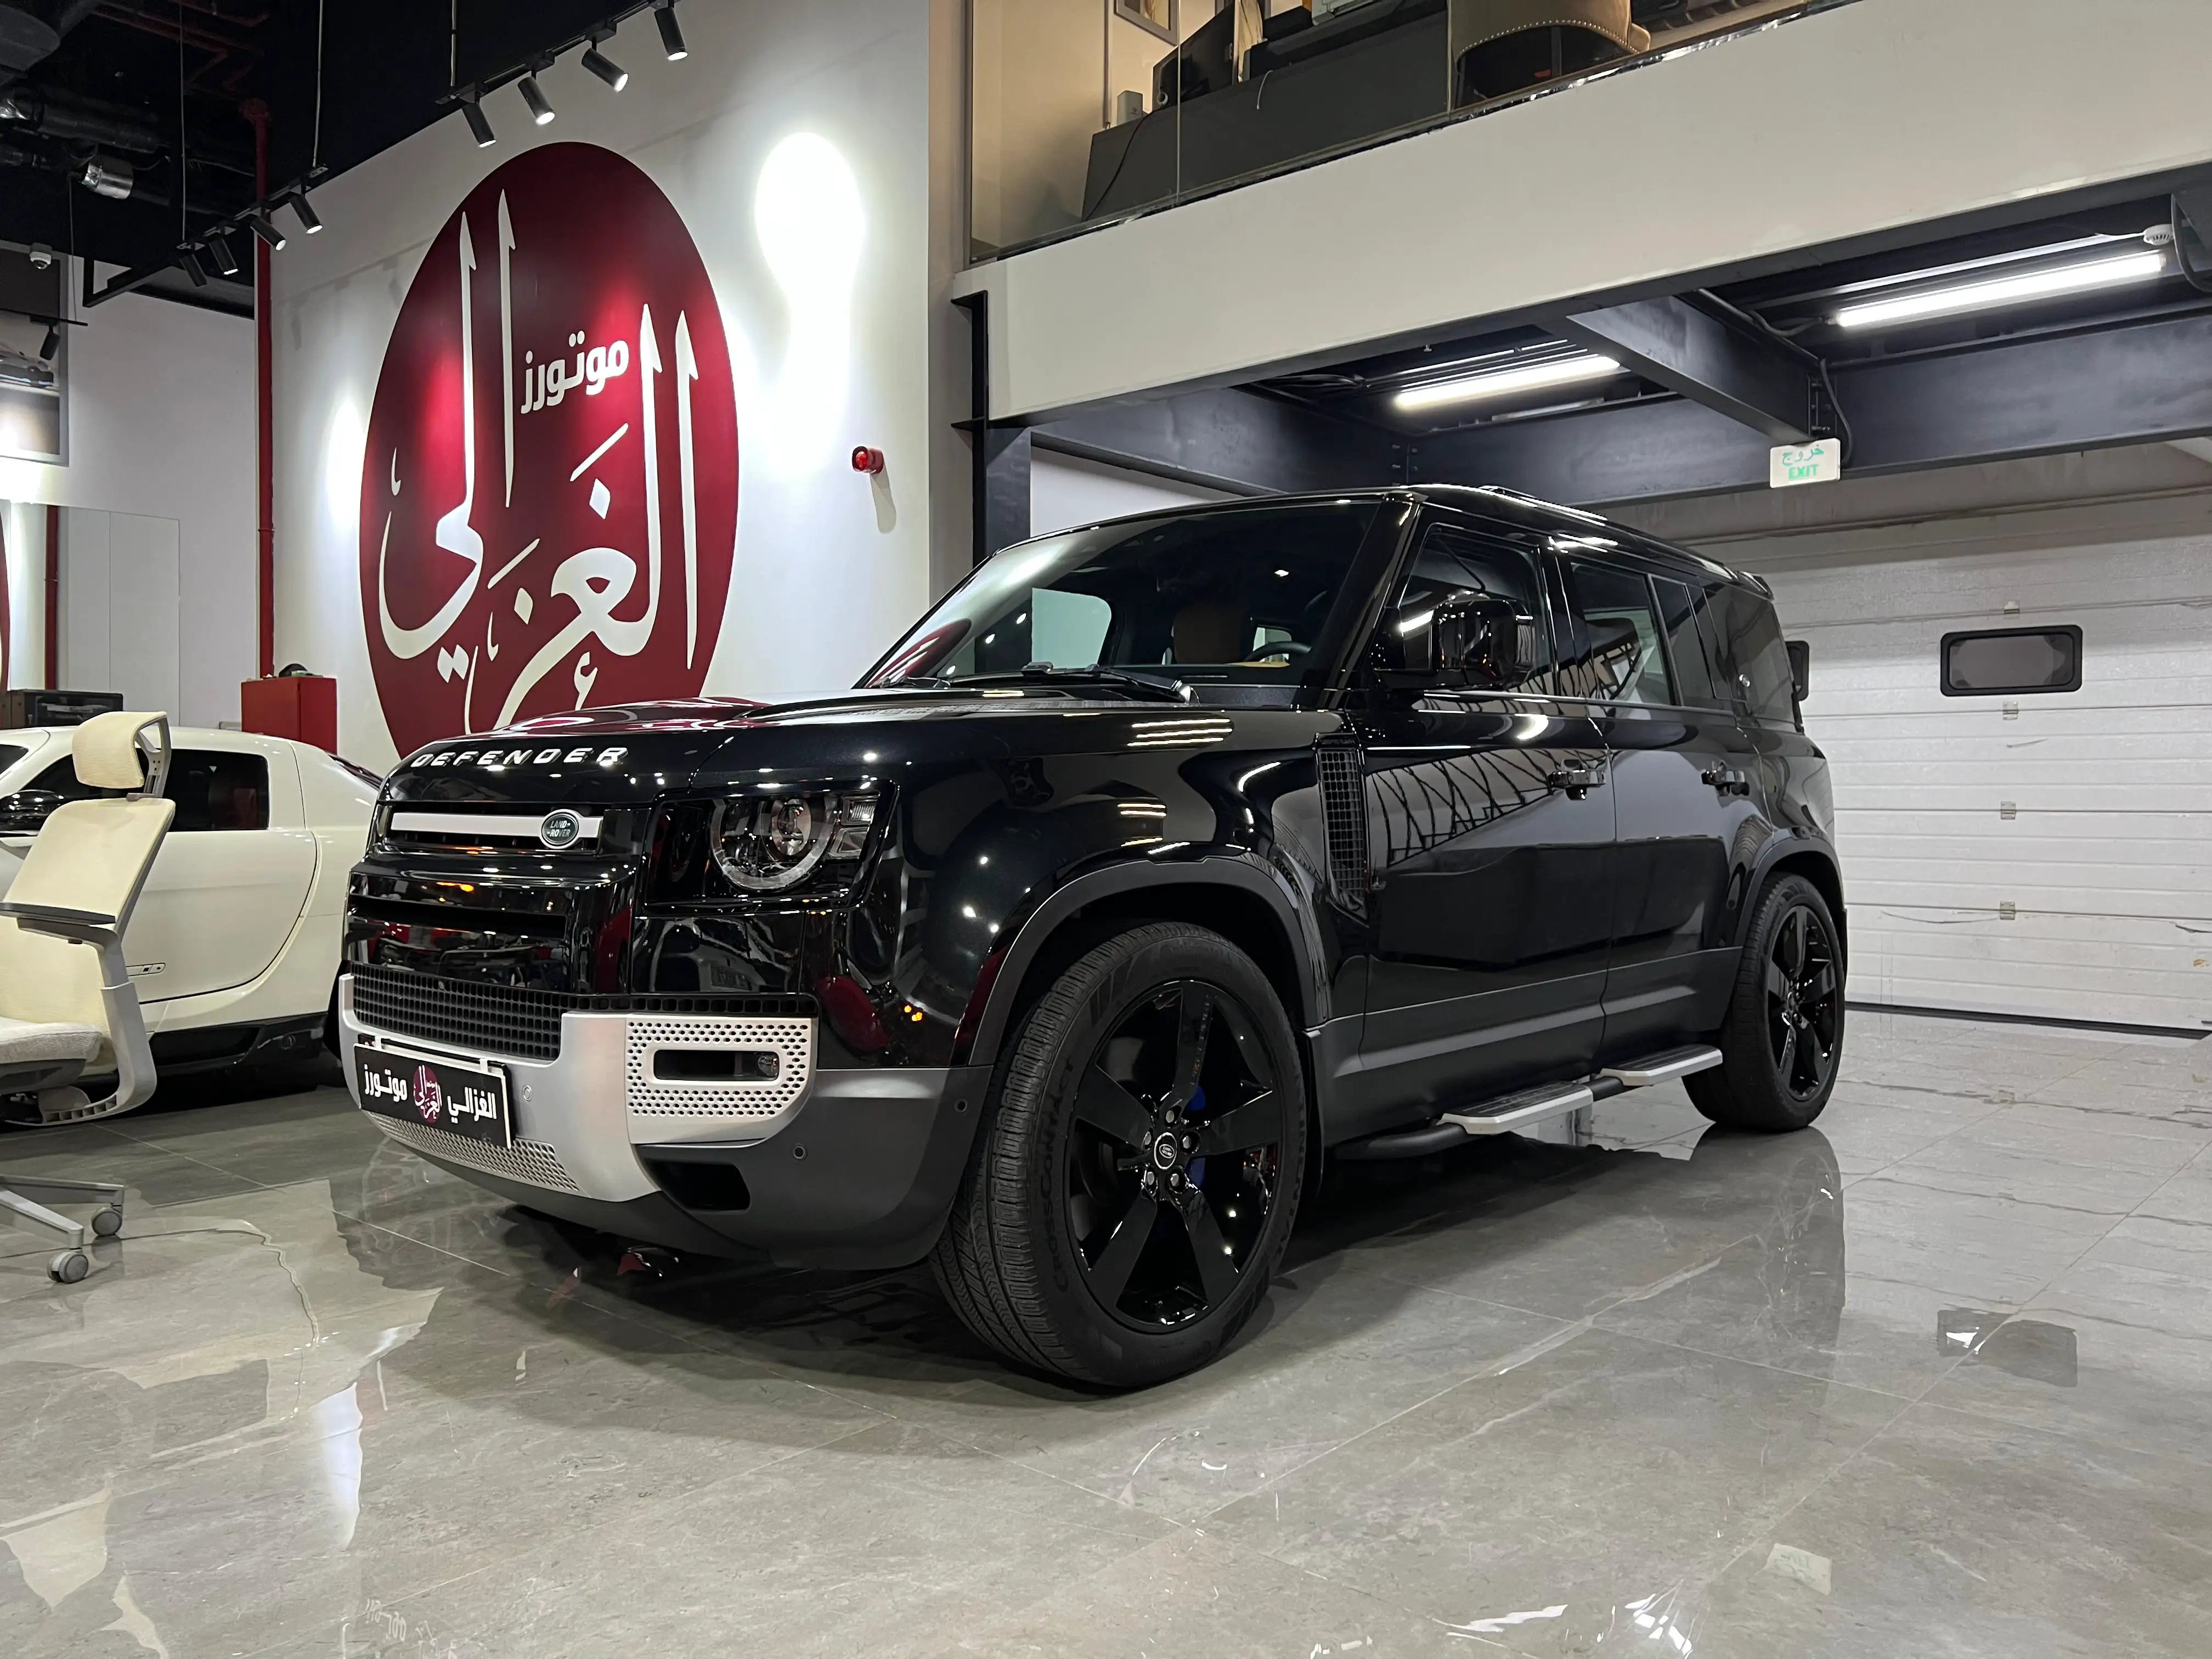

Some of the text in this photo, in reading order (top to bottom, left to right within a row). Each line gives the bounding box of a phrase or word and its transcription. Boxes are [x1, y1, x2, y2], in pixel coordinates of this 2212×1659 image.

[521, 330, 629, 414] موتورز
[1782, 444, 1824, 466] خروج
[1788, 464, 1819, 481] EXIT
[410, 747, 628, 768] DEFENDER
[364, 1064, 497, 1124] الغزالي موتورز
